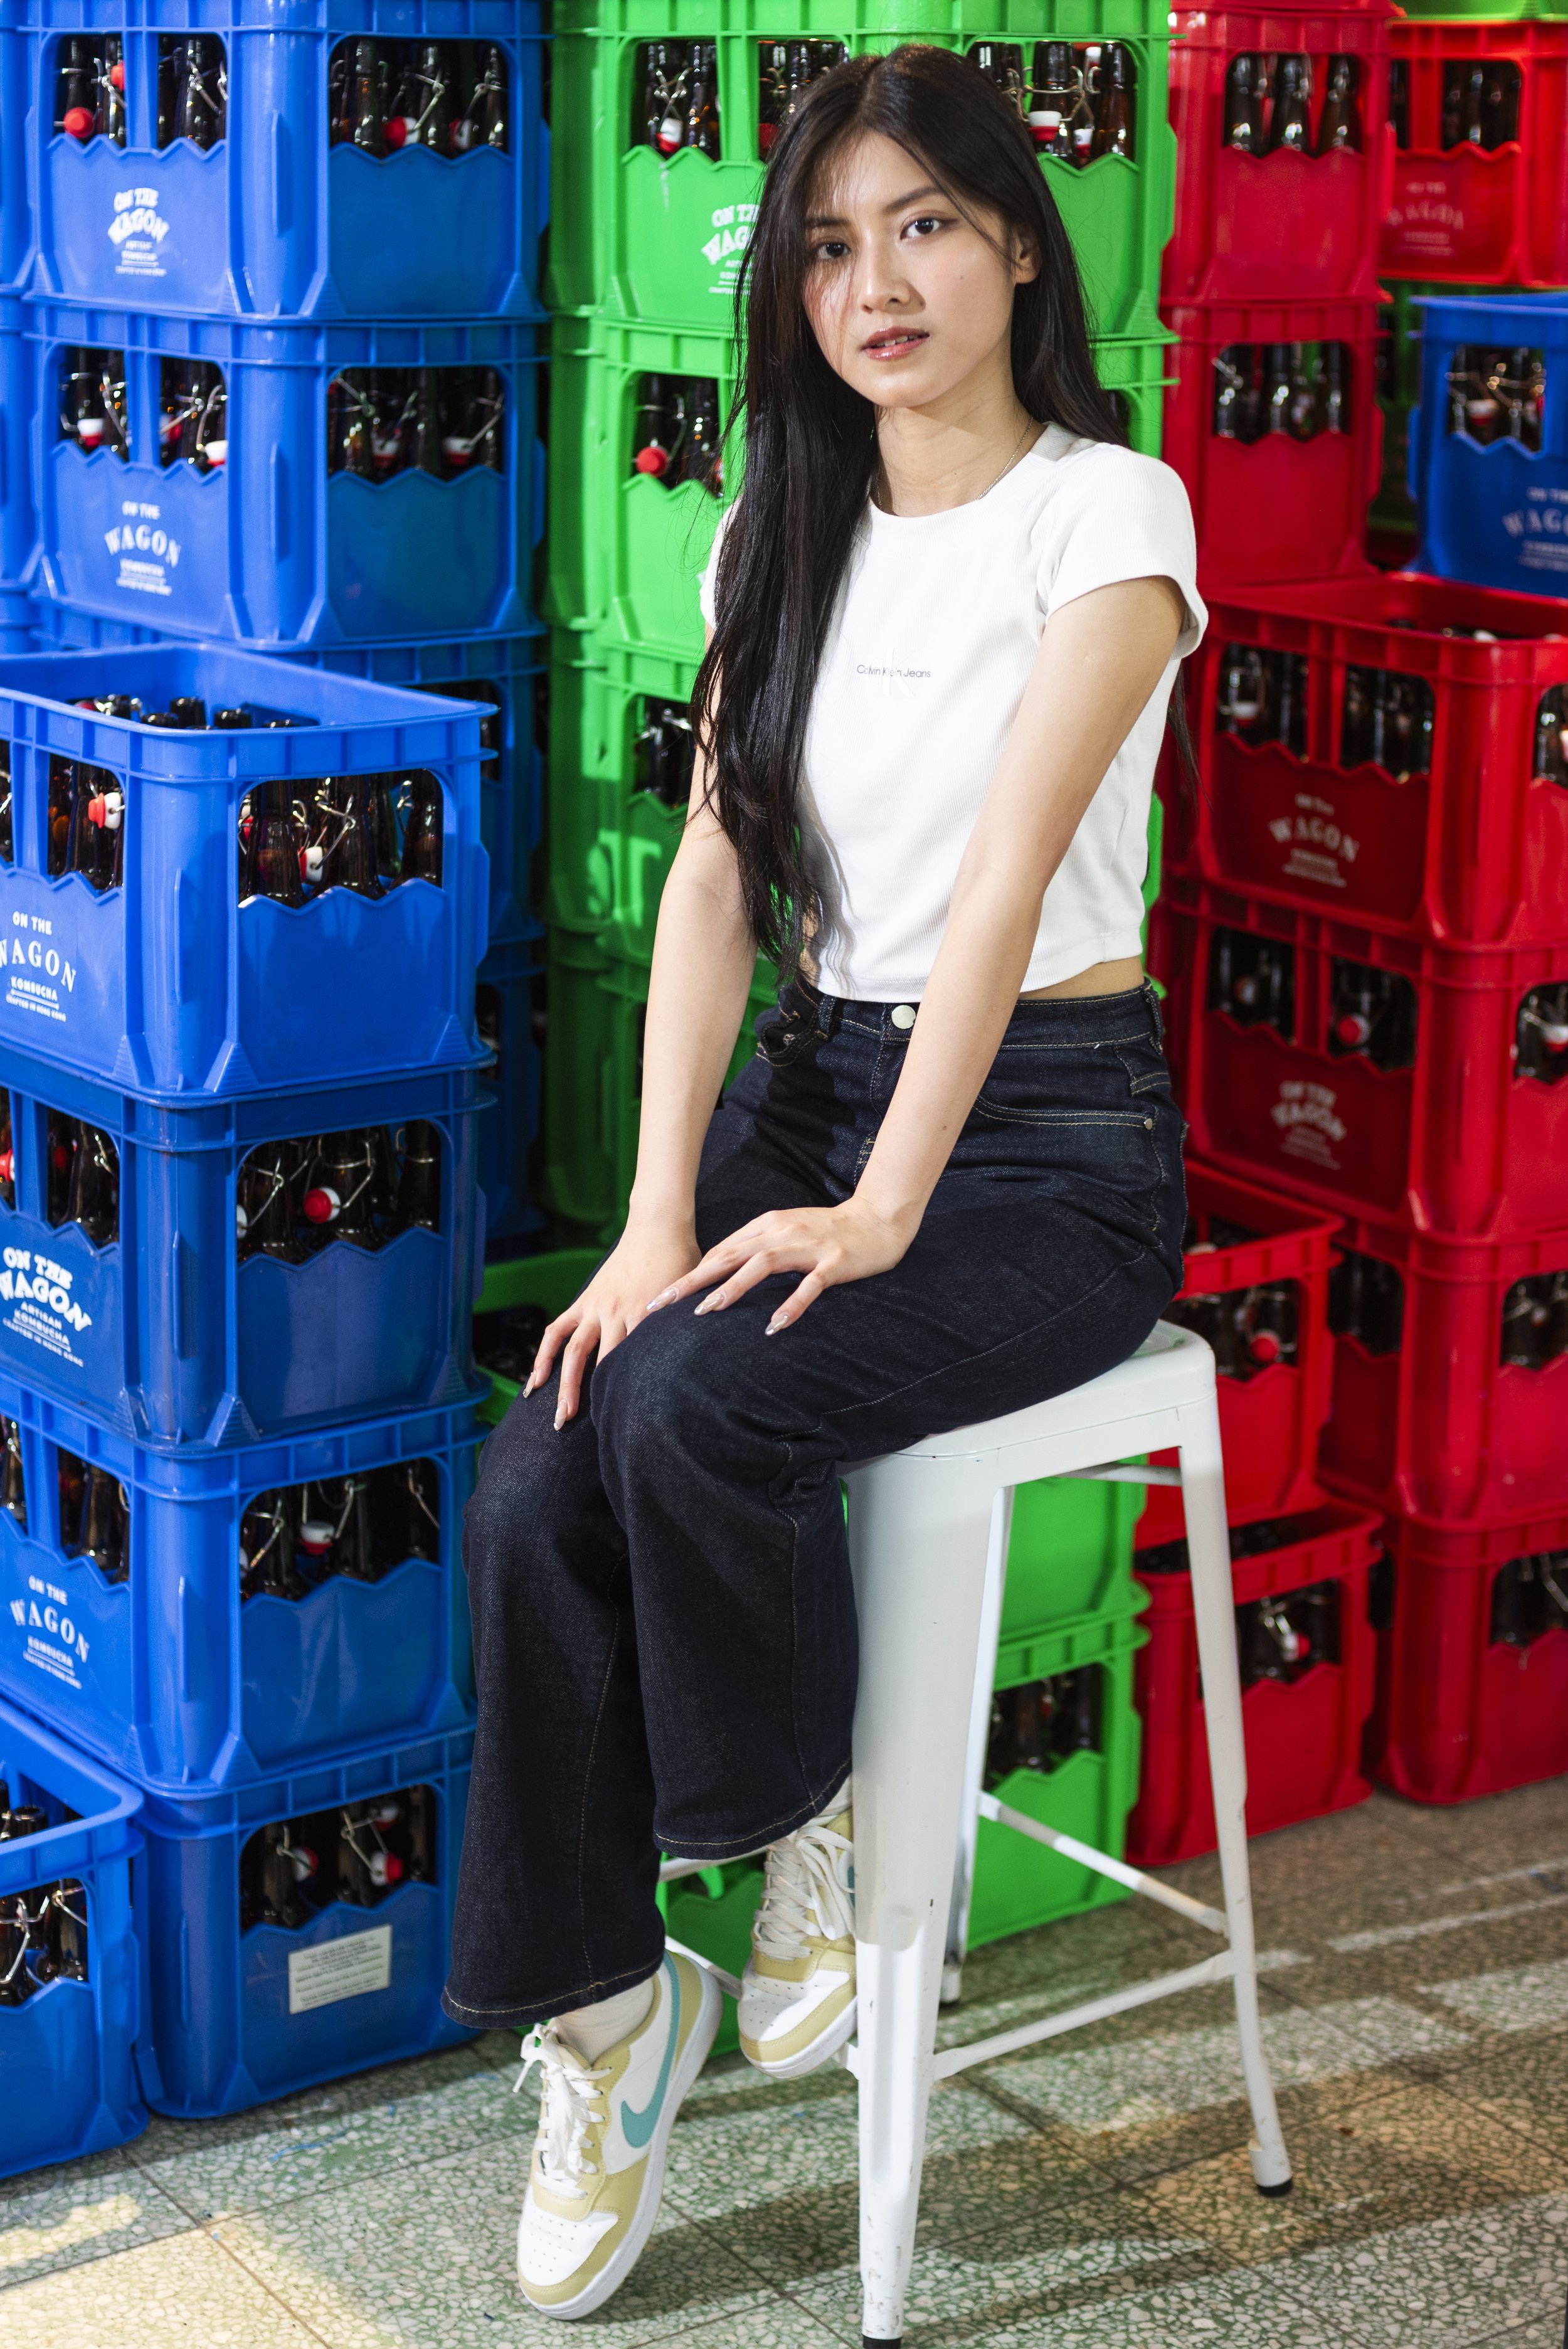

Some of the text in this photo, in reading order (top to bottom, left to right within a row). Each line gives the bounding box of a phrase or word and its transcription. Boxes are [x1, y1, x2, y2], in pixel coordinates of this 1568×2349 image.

[108, 208, 170, 245] WAGON
[712, 205, 734, 228] ON
[701, 225, 751, 265] WAG
[139, 503, 161, 520] THE
[103, 524, 181, 568] WAGON
[857, 664, 931, 677] Calvin Klein Jeans
[13, 911, 52, 936] ON THE
[11, 975, 58, 1002] KOMBUCHA
[3, 1246, 73, 1290] ON THE
[0, 1270, 92, 1332] WAGON
[21, 1301, 62, 1330] ARTISAN
[14, 1308, 70, 1346] KOMBUCHA
[28, 1575, 68, 1606] ON THE
[9, 1598, 90, 1663] WAGON
